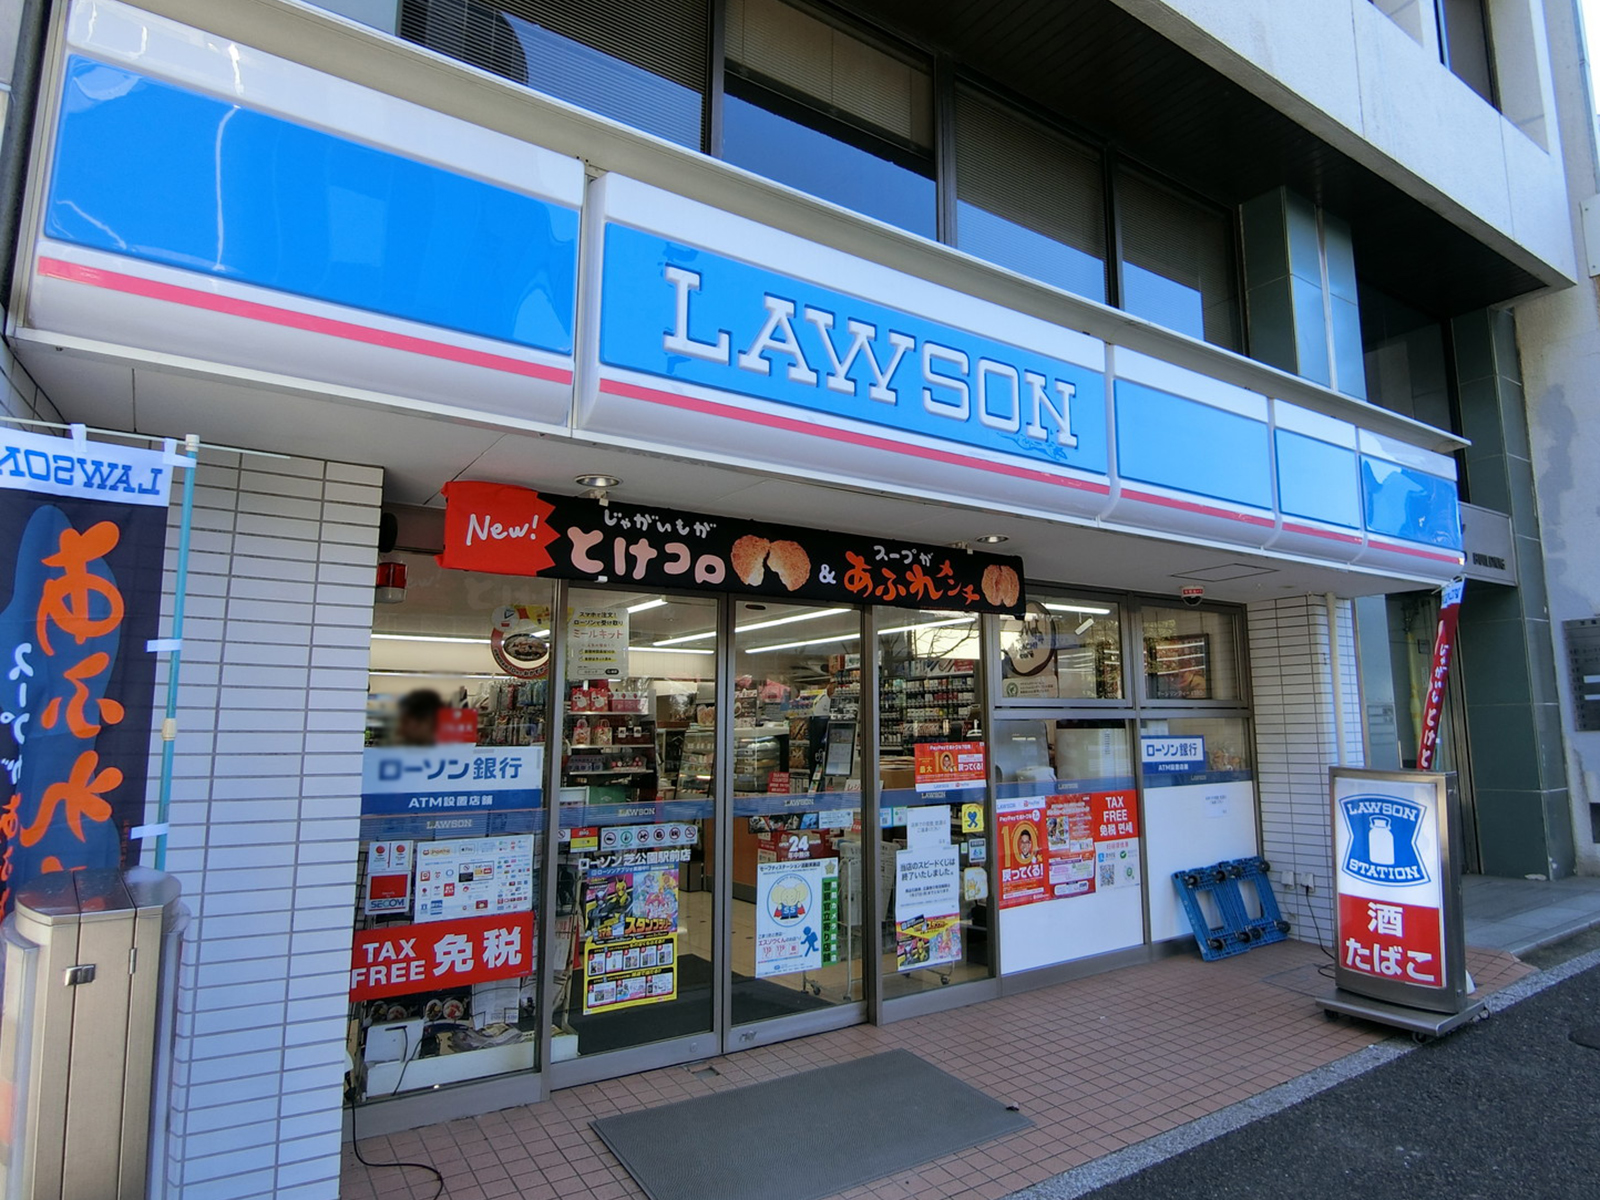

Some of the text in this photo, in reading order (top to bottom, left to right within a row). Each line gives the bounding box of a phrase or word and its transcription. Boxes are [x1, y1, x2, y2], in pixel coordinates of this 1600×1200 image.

[663, 263, 1079, 449] LAWSON
[466, 513, 539, 546] New!
[604, 509, 717, 538] じゃがいもが
[570, 526, 726, 584] とけコロ
[873, 545, 934, 567] スープが
[819, 563, 836, 584] &
[1146, 743, 1198, 757] ローソン銀行
[379, 757, 522, 781] ローソン銀行
[408, 795, 493, 808] ATM設置店舗
[1105, 796, 1124, 809] TAX
[1347, 801, 1417, 822] LAWSON
[426, 819, 472, 829] LAWSON
[1103, 809, 1128, 822] FREE
[789, 835, 809, 852] 24
[1349, 858, 1420, 880] STATION
[371, 899, 405, 909] SECOM
[1367, 901, 1404, 937] 酒
[363, 938, 416, 963] TAX
[433, 926, 522, 976] 免税
[1345, 937, 1435, 982] たばこ
[351, 960, 425, 989] FREE
